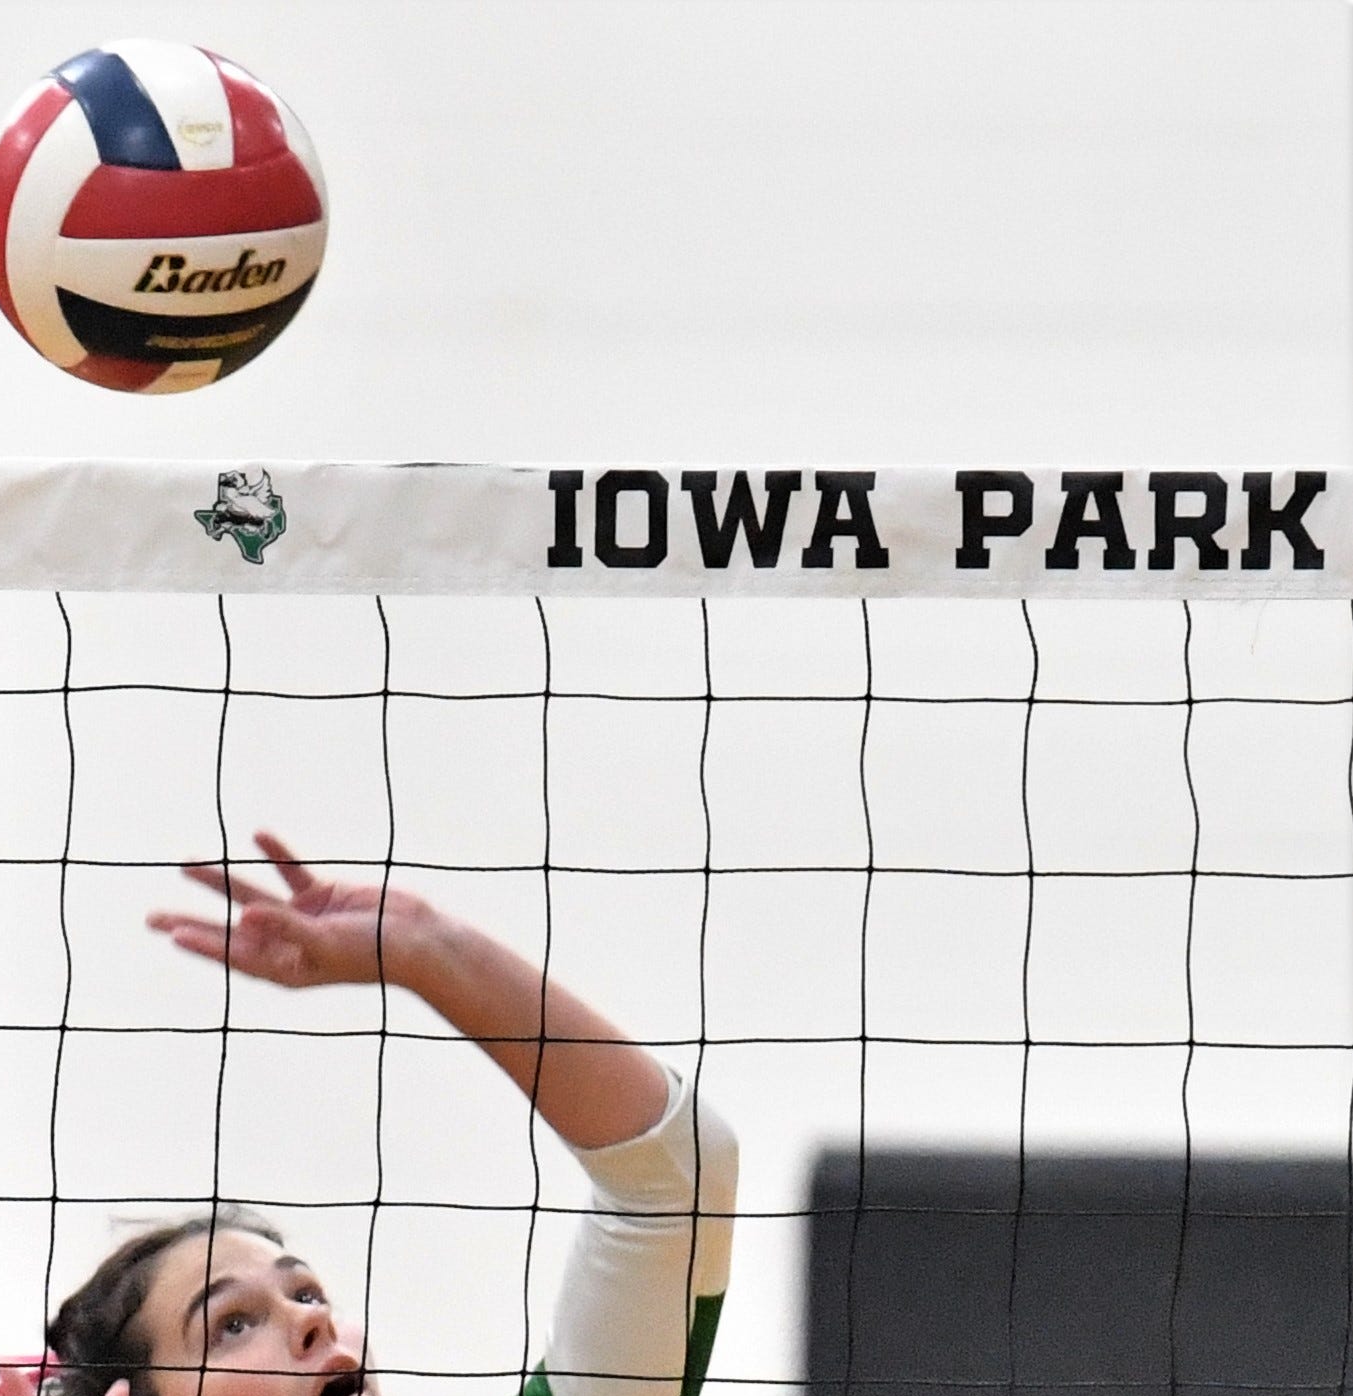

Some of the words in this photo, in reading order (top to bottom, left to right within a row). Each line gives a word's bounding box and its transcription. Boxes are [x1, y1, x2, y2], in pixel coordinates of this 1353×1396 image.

[133, 249, 287, 294] Baden
[547, 469, 890, 569] IOWA
[955, 470, 1328, 571] PARK
